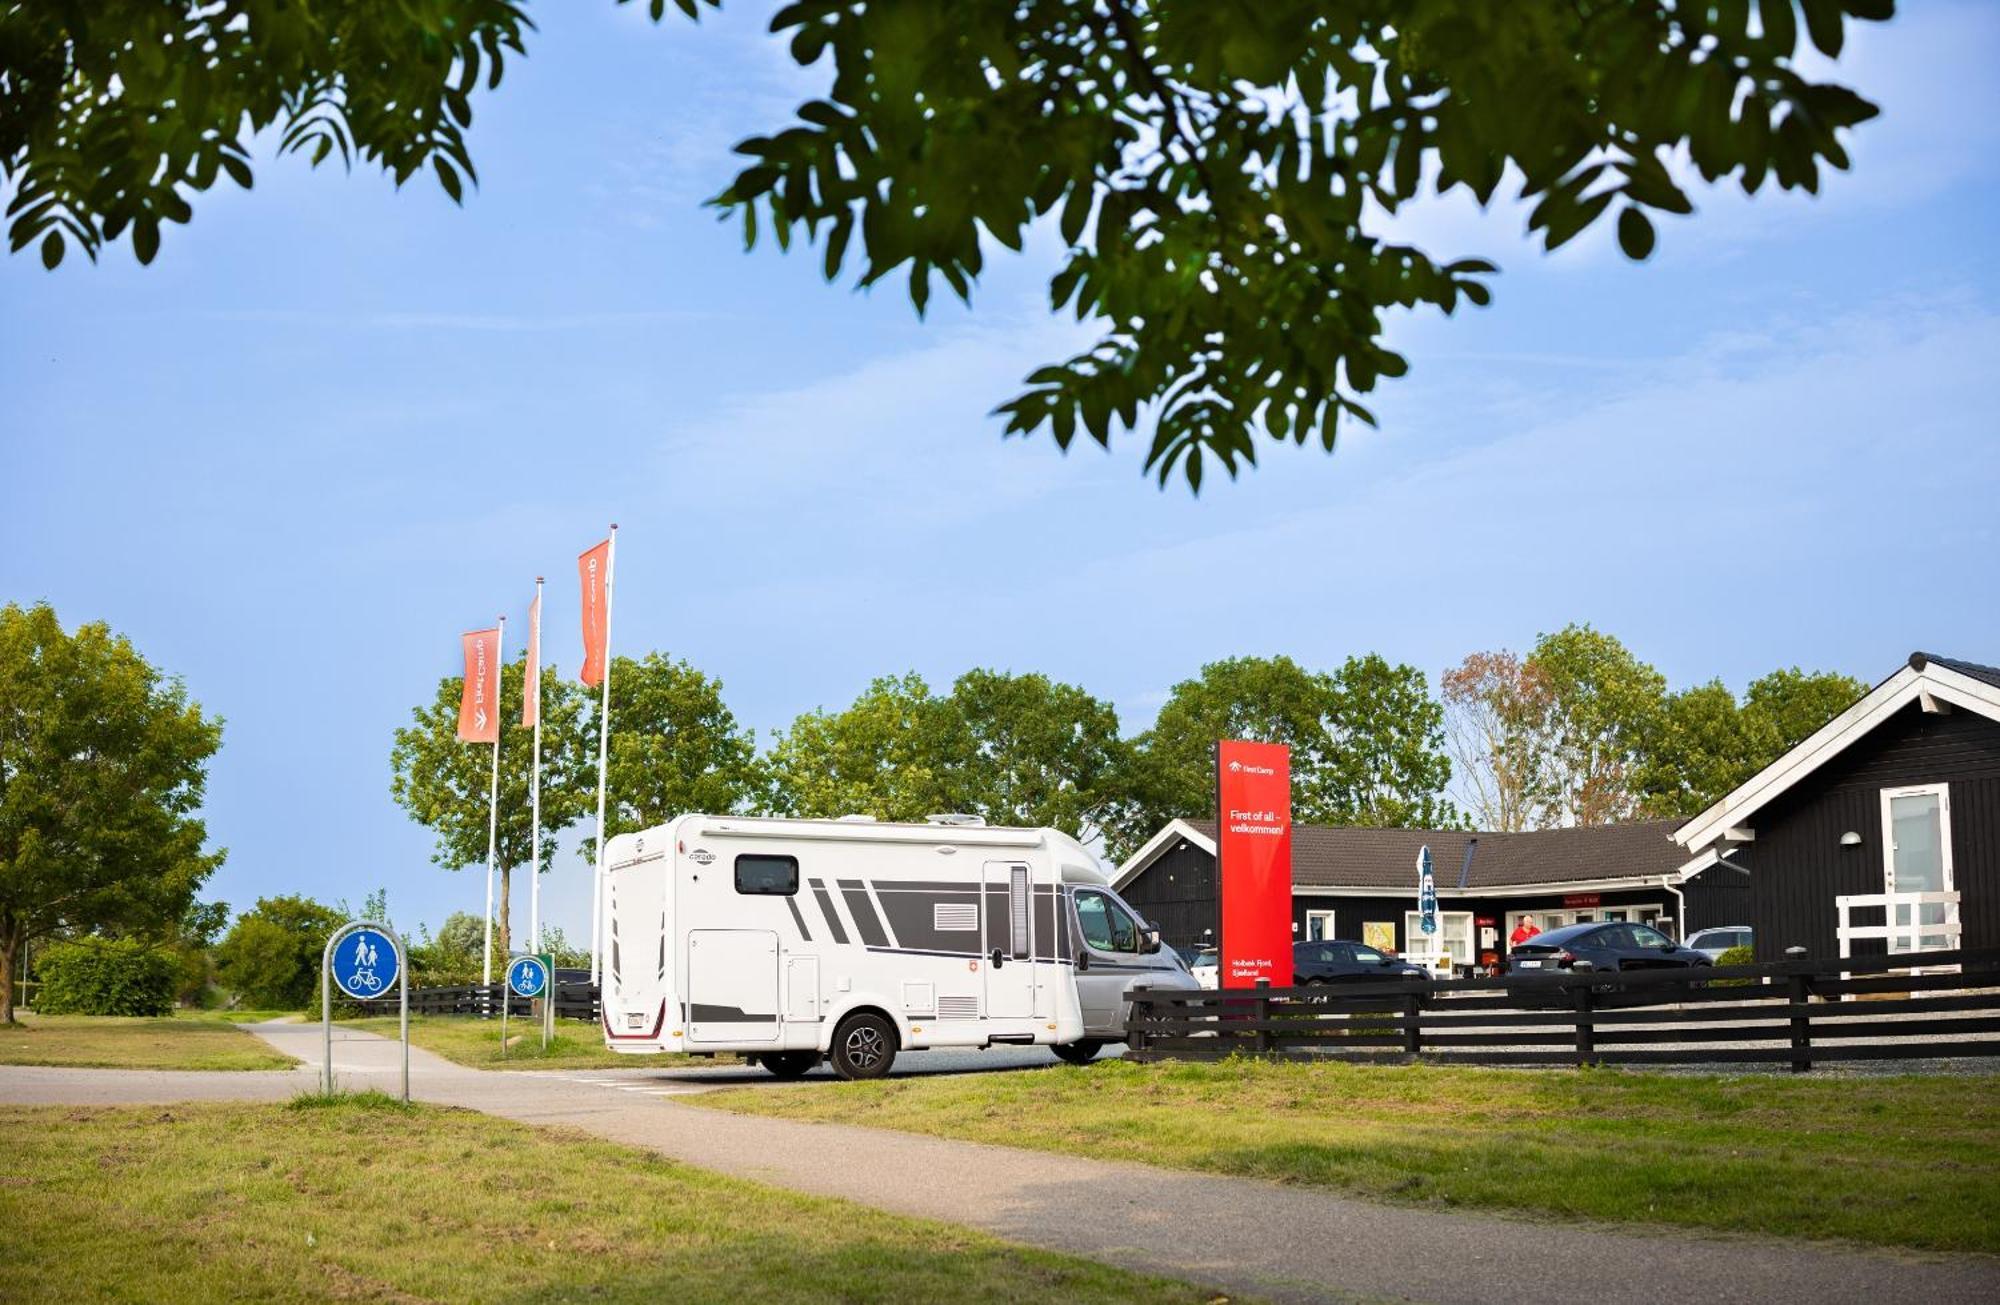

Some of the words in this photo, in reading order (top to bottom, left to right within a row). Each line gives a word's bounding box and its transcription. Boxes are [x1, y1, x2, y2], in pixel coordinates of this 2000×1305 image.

[1230, 810, 1251, 820] First
[1253, 811, 1263, 821] of
[1264, 811, 1274, 821] all
[1230, 823, 1284, 835] velkommen!
